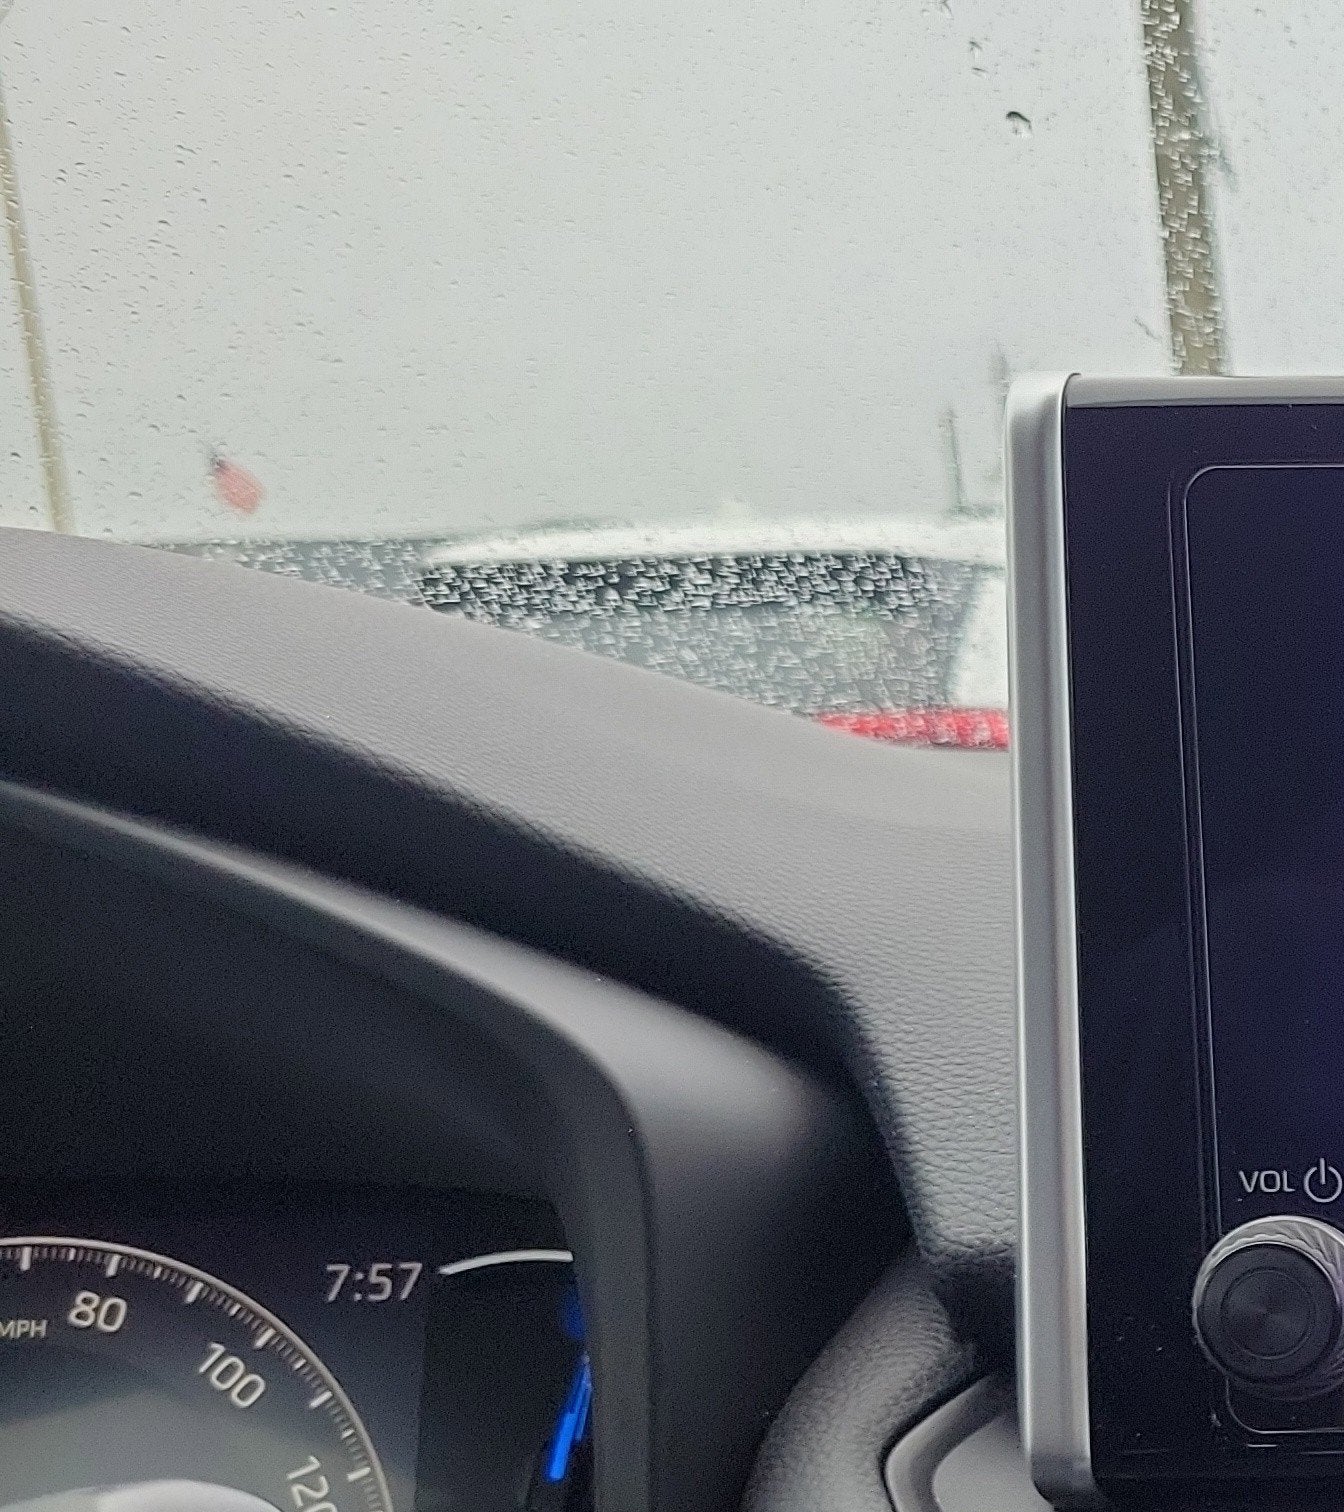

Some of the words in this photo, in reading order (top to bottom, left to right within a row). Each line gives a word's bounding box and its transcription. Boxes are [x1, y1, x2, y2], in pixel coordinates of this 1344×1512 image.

[1238, 1169, 1296, 1193] VOL
[324, 1261, 424, 1303] 7:57
[0, 1319, 48, 1339] MPH
[67, 1290, 129, 1333] 80
[198, 1341, 266, 1409] 100
